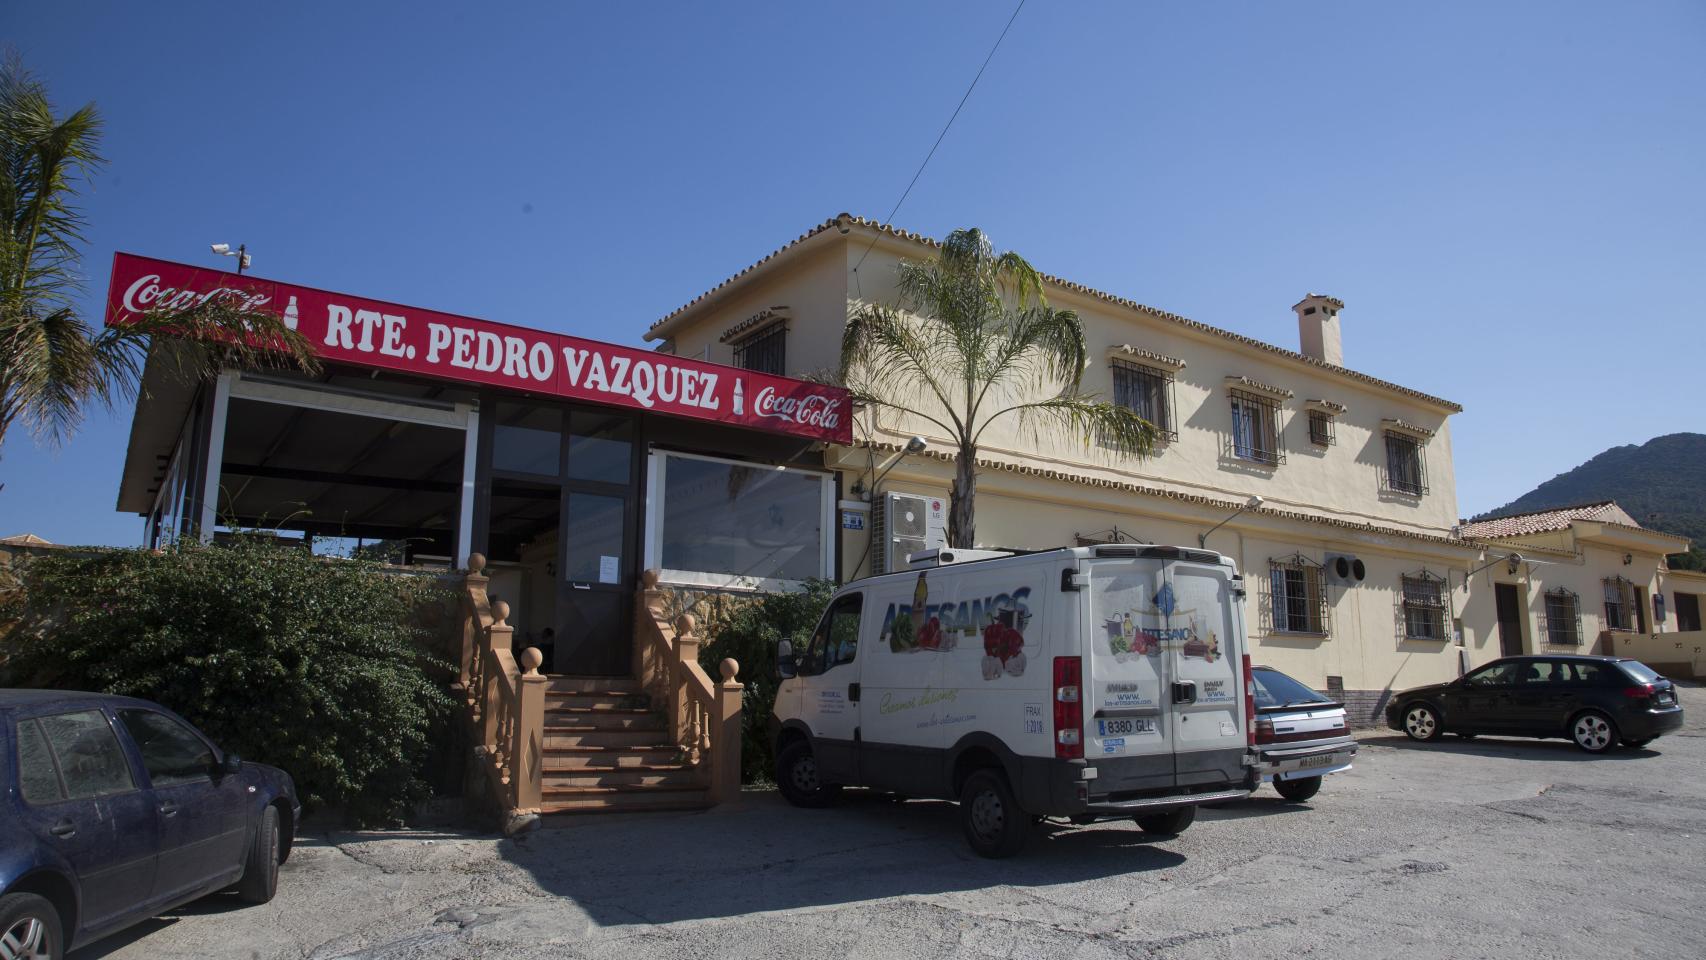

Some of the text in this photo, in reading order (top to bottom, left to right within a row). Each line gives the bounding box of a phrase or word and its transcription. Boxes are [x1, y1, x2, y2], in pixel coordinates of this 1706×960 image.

[324, 304, 719, 407] RTE. PEDRO VAZQUEZ
[754, 386, 839, 430] Coca-Cola
[1107, 718, 1154, 734] 8380 GLL
